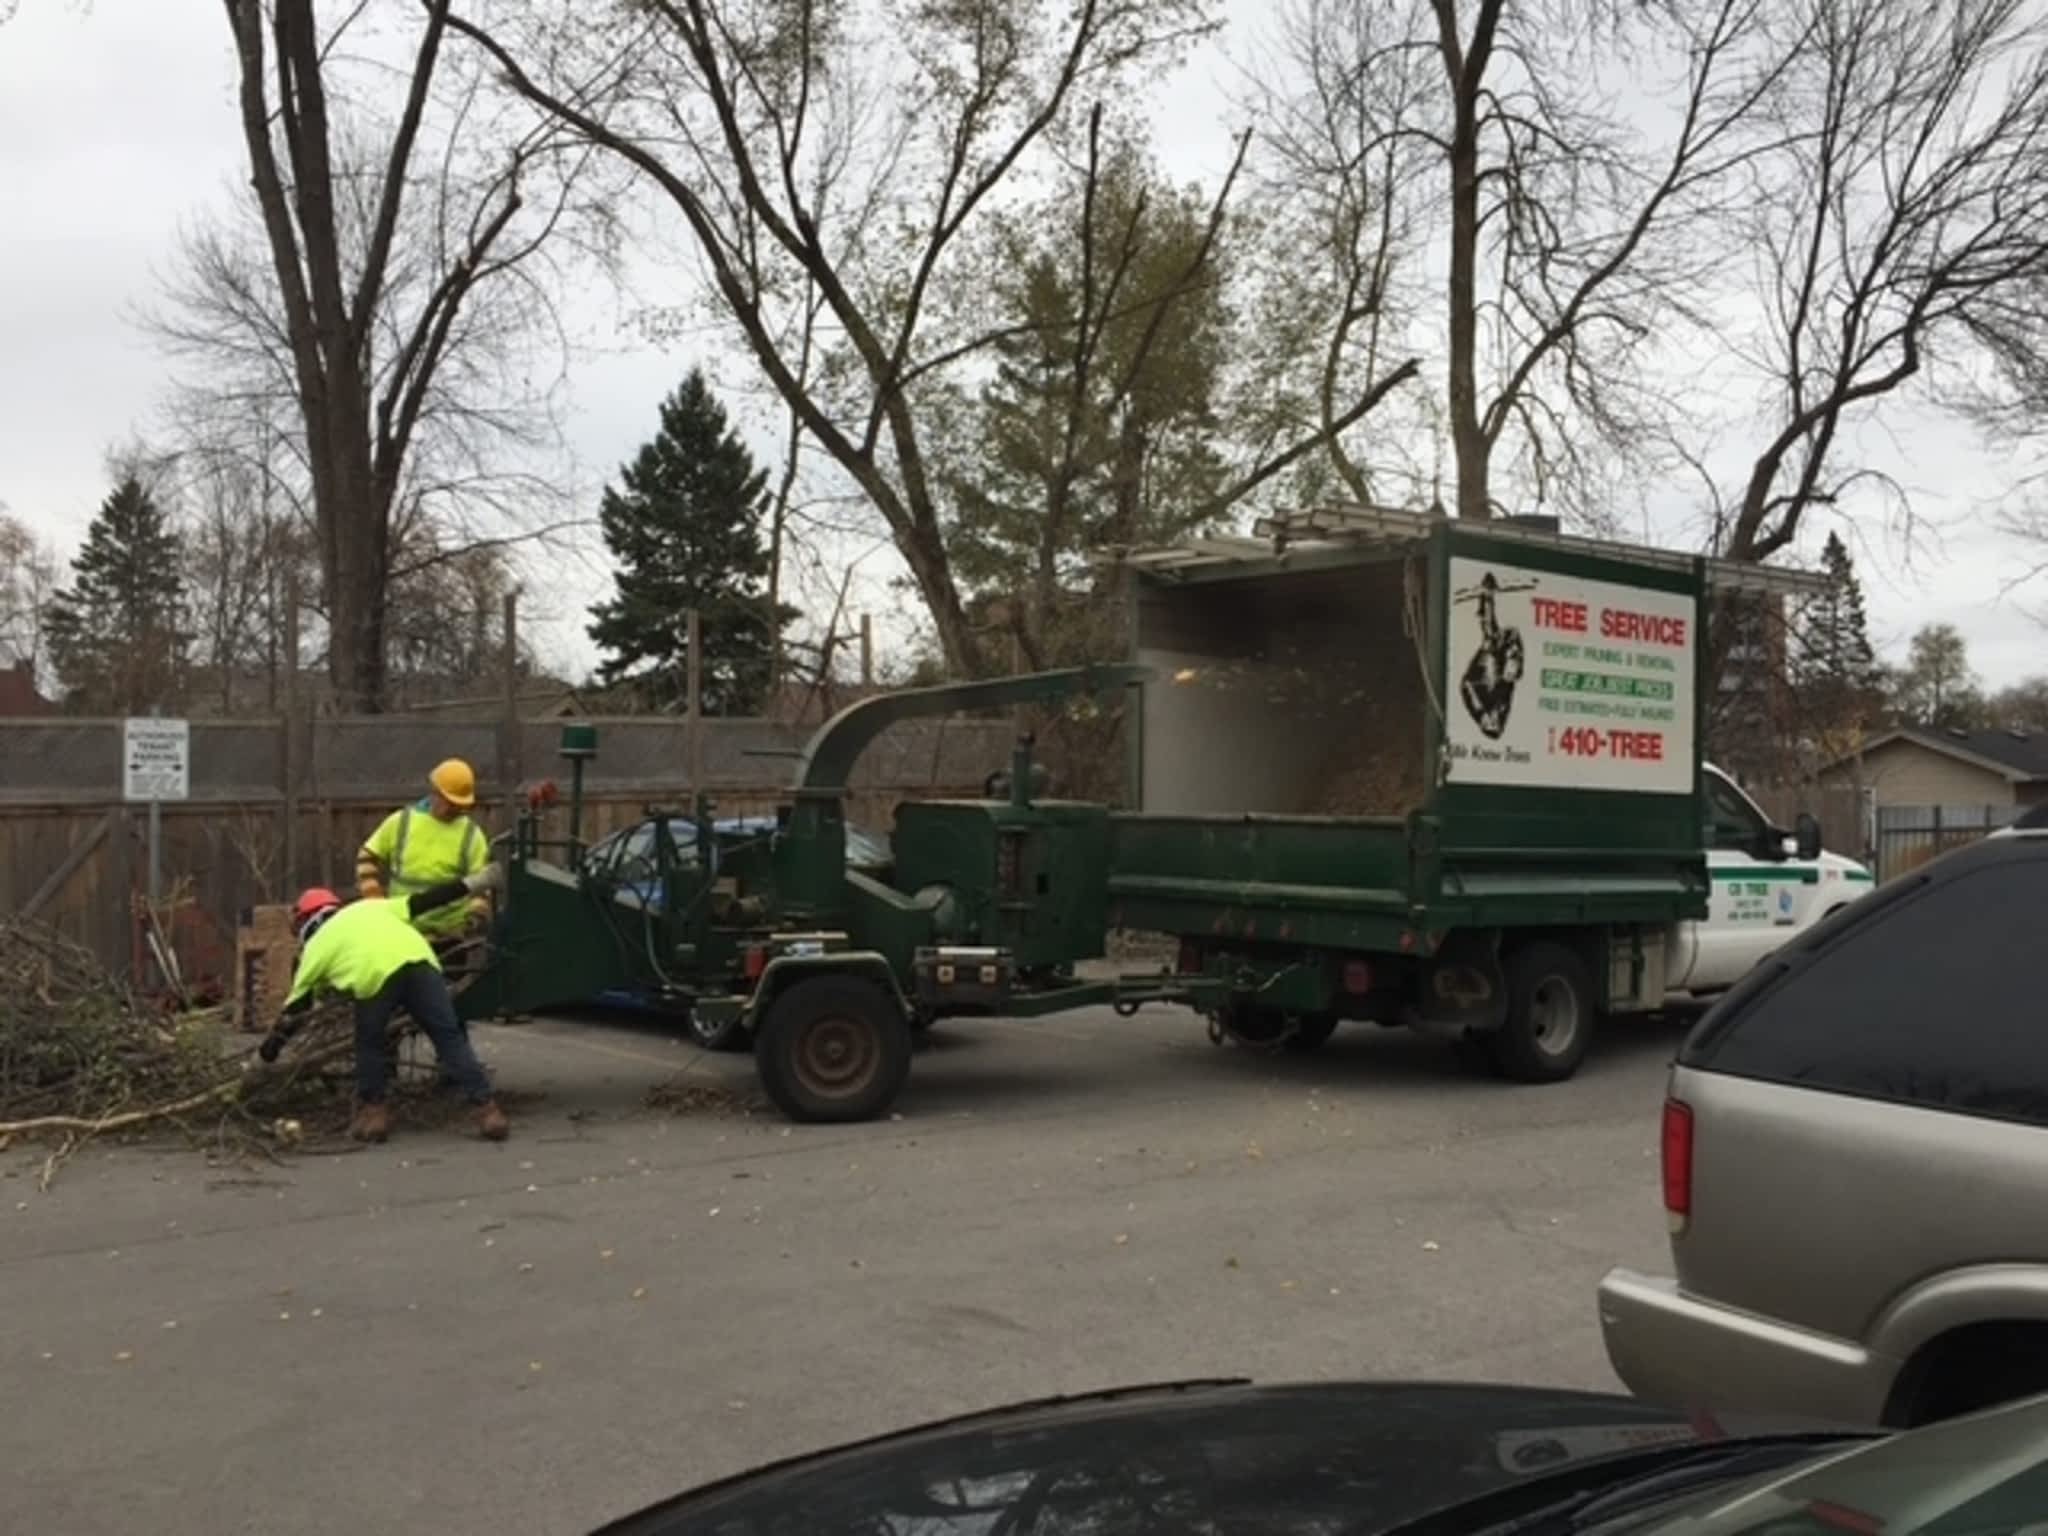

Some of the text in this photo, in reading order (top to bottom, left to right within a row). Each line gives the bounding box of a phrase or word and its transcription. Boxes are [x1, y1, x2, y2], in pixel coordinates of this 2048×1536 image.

[1531, 597, 1684, 646] TREE SERVICE
[1543, 642, 1580, 659] EXPERT
[1584, 646, 1621, 664] PRUNING
[1538, 697, 1558, 710] FREE
[1560, 726, 1663, 761] 410-TREE
